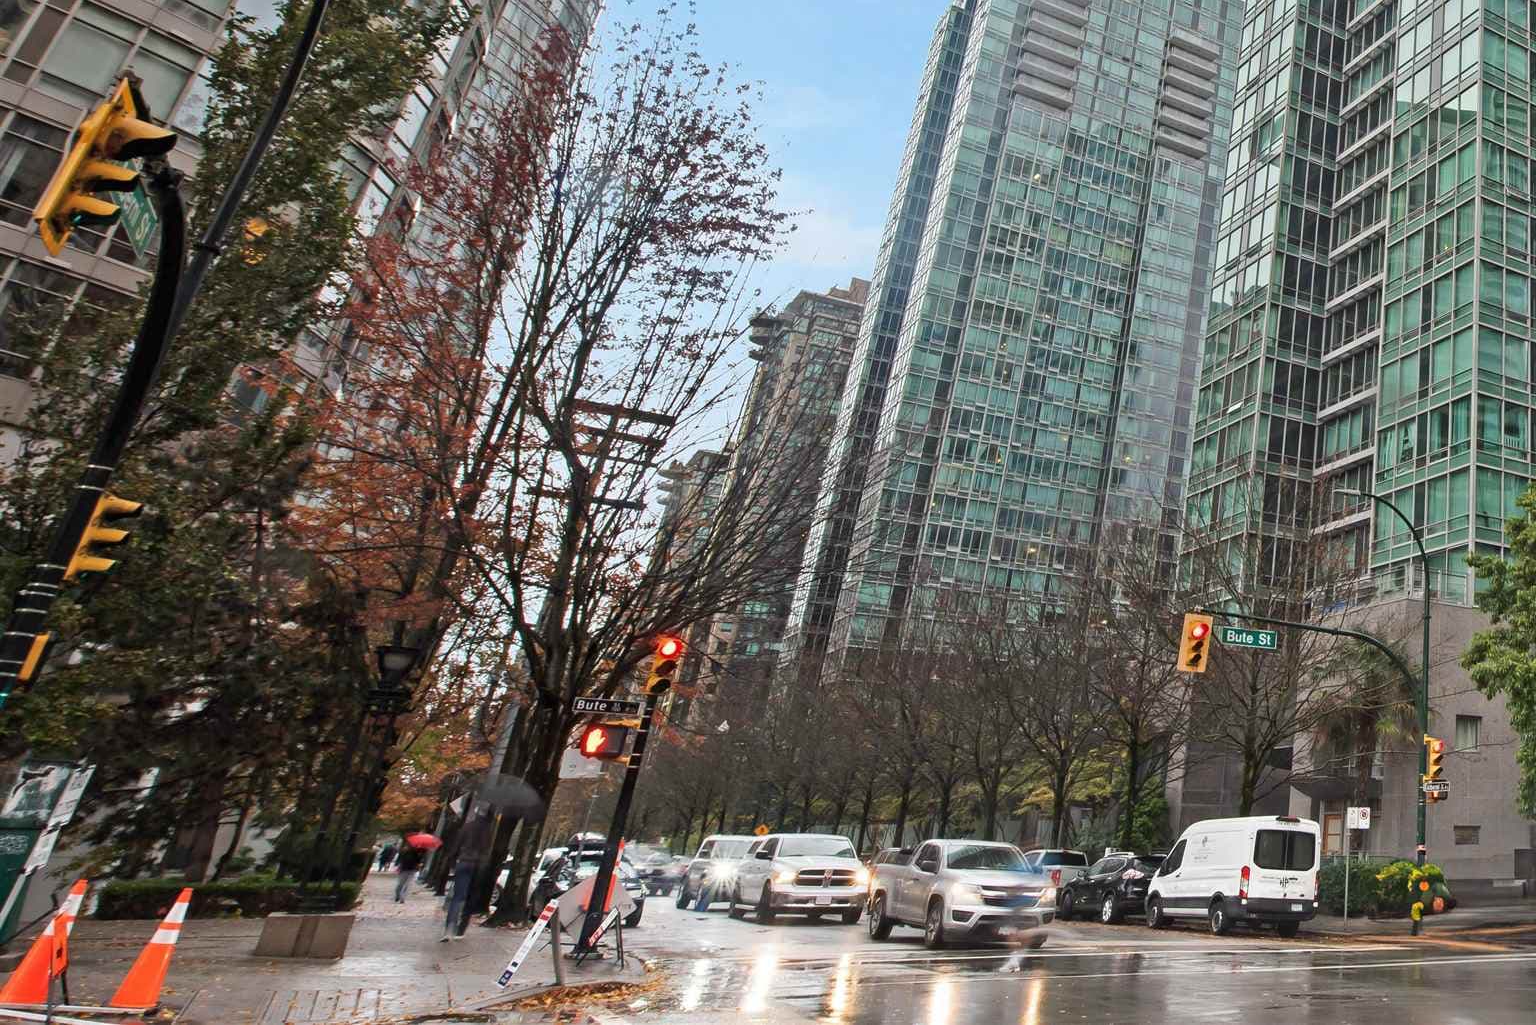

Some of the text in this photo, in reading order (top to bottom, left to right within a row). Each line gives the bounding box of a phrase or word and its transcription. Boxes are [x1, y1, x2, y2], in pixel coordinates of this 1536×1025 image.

[1226, 630, 1271, 645] Bute St
[576, 699, 607, 711] Bute
